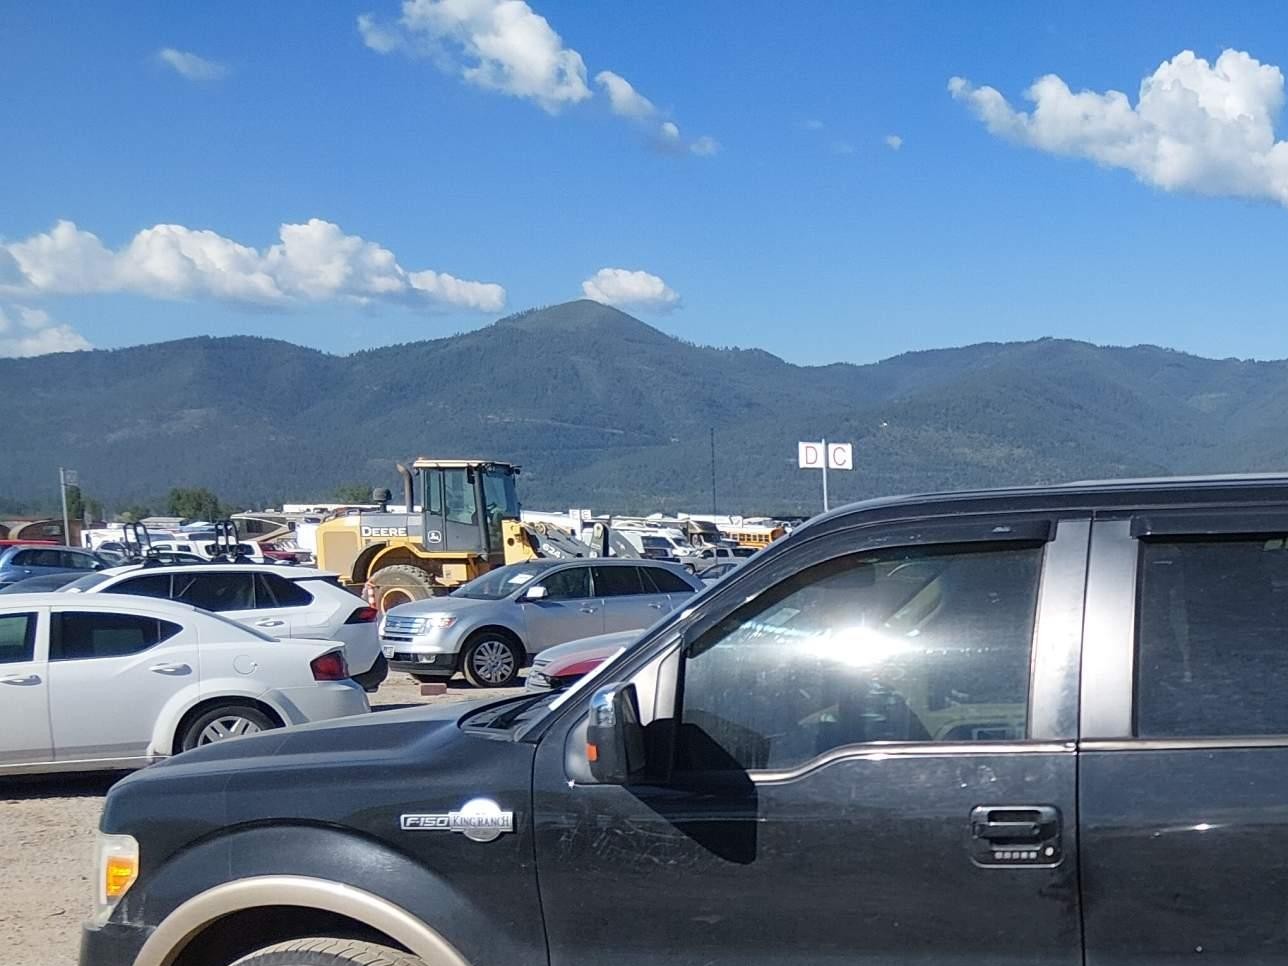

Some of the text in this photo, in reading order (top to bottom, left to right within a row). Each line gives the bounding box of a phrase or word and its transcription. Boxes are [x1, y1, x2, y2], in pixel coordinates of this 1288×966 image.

[805, 446, 818, 465] D
[833, 447, 846, 466] C
[361, 526, 408, 537] DEERE
[405, 816, 449, 827] F-150
